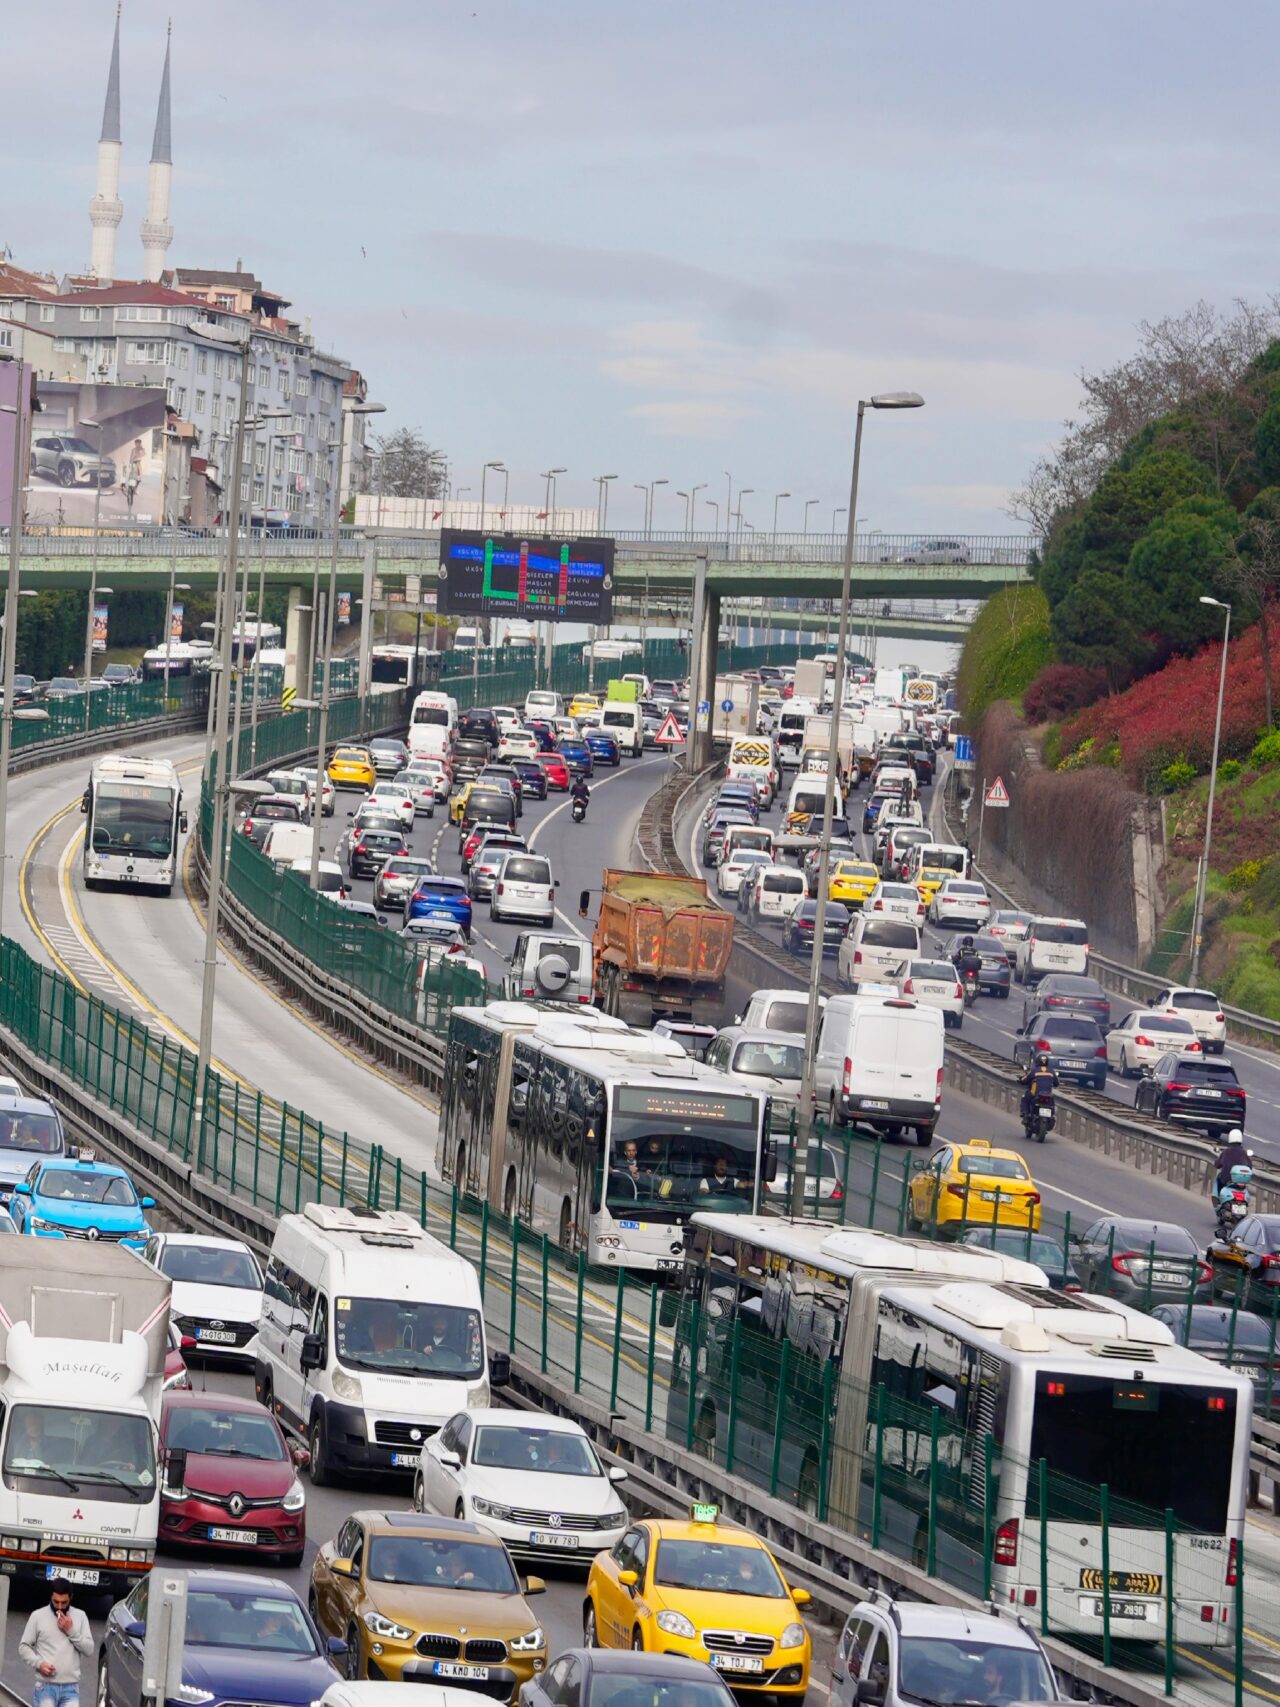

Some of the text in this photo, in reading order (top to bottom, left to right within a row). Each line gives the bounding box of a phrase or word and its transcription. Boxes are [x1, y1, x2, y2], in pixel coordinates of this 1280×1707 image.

[43, 1532, 109, 1546] MITSUBISHI
[213, 1530, 223, 1539] 34
[225, 1531, 240, 1541] MTY
[562, 1537, 577, 1546] 783
[52, 1567, 98, 1582] 22 HY 546
[439, 1663, 449, 1673] 34
[472, 1667, 487, 1678] 104
[714, 1656, 725, 1667] 34
[751, 1660, 761, 1671] 77
